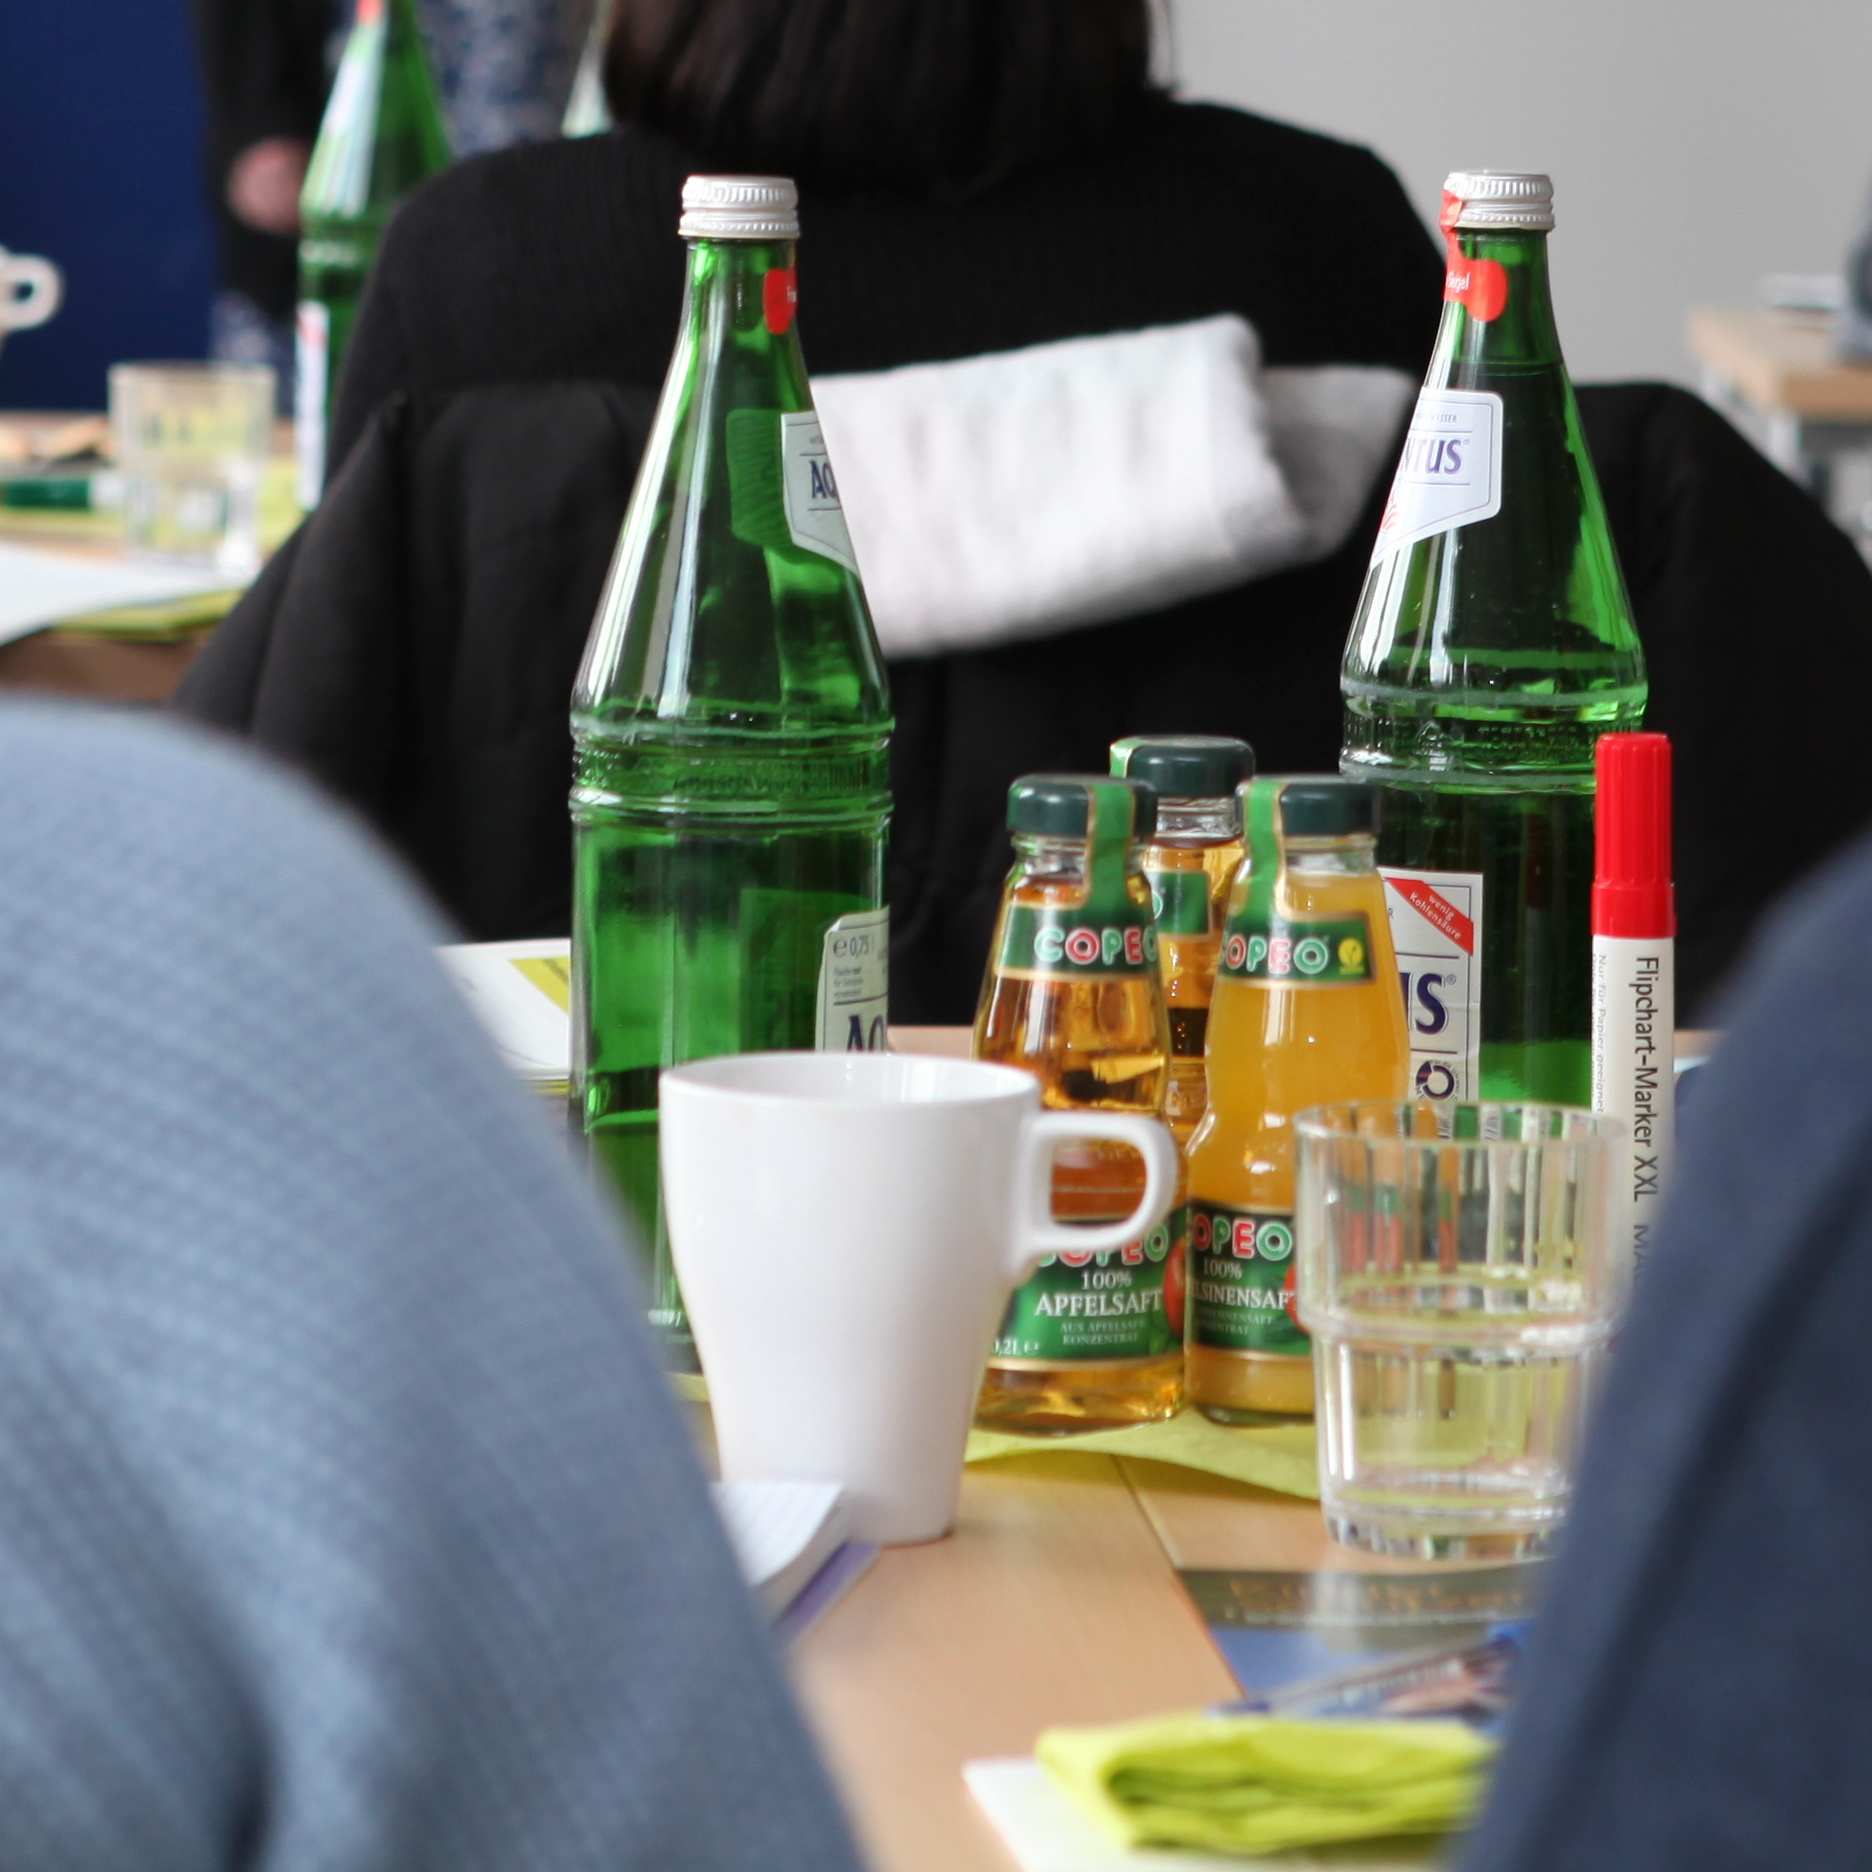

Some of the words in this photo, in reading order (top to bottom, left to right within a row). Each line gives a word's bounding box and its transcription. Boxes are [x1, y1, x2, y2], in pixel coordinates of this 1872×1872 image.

[1409, 891, 1462, 940] Kohlensäure
[1429, 894, 1455, 922] wenig
[1223, 934, 1329, 975] OPEO
[1628, 956, 1659, 1148] Flipchart-Marker
[1634, 1154, 1658, 1203] XXL
[1082, 1271, 1132, 1290] 100%
[1202, 1259, 1243, 1280] 100%
[1034, 1290, 1164, 1317] APFELSAFT
